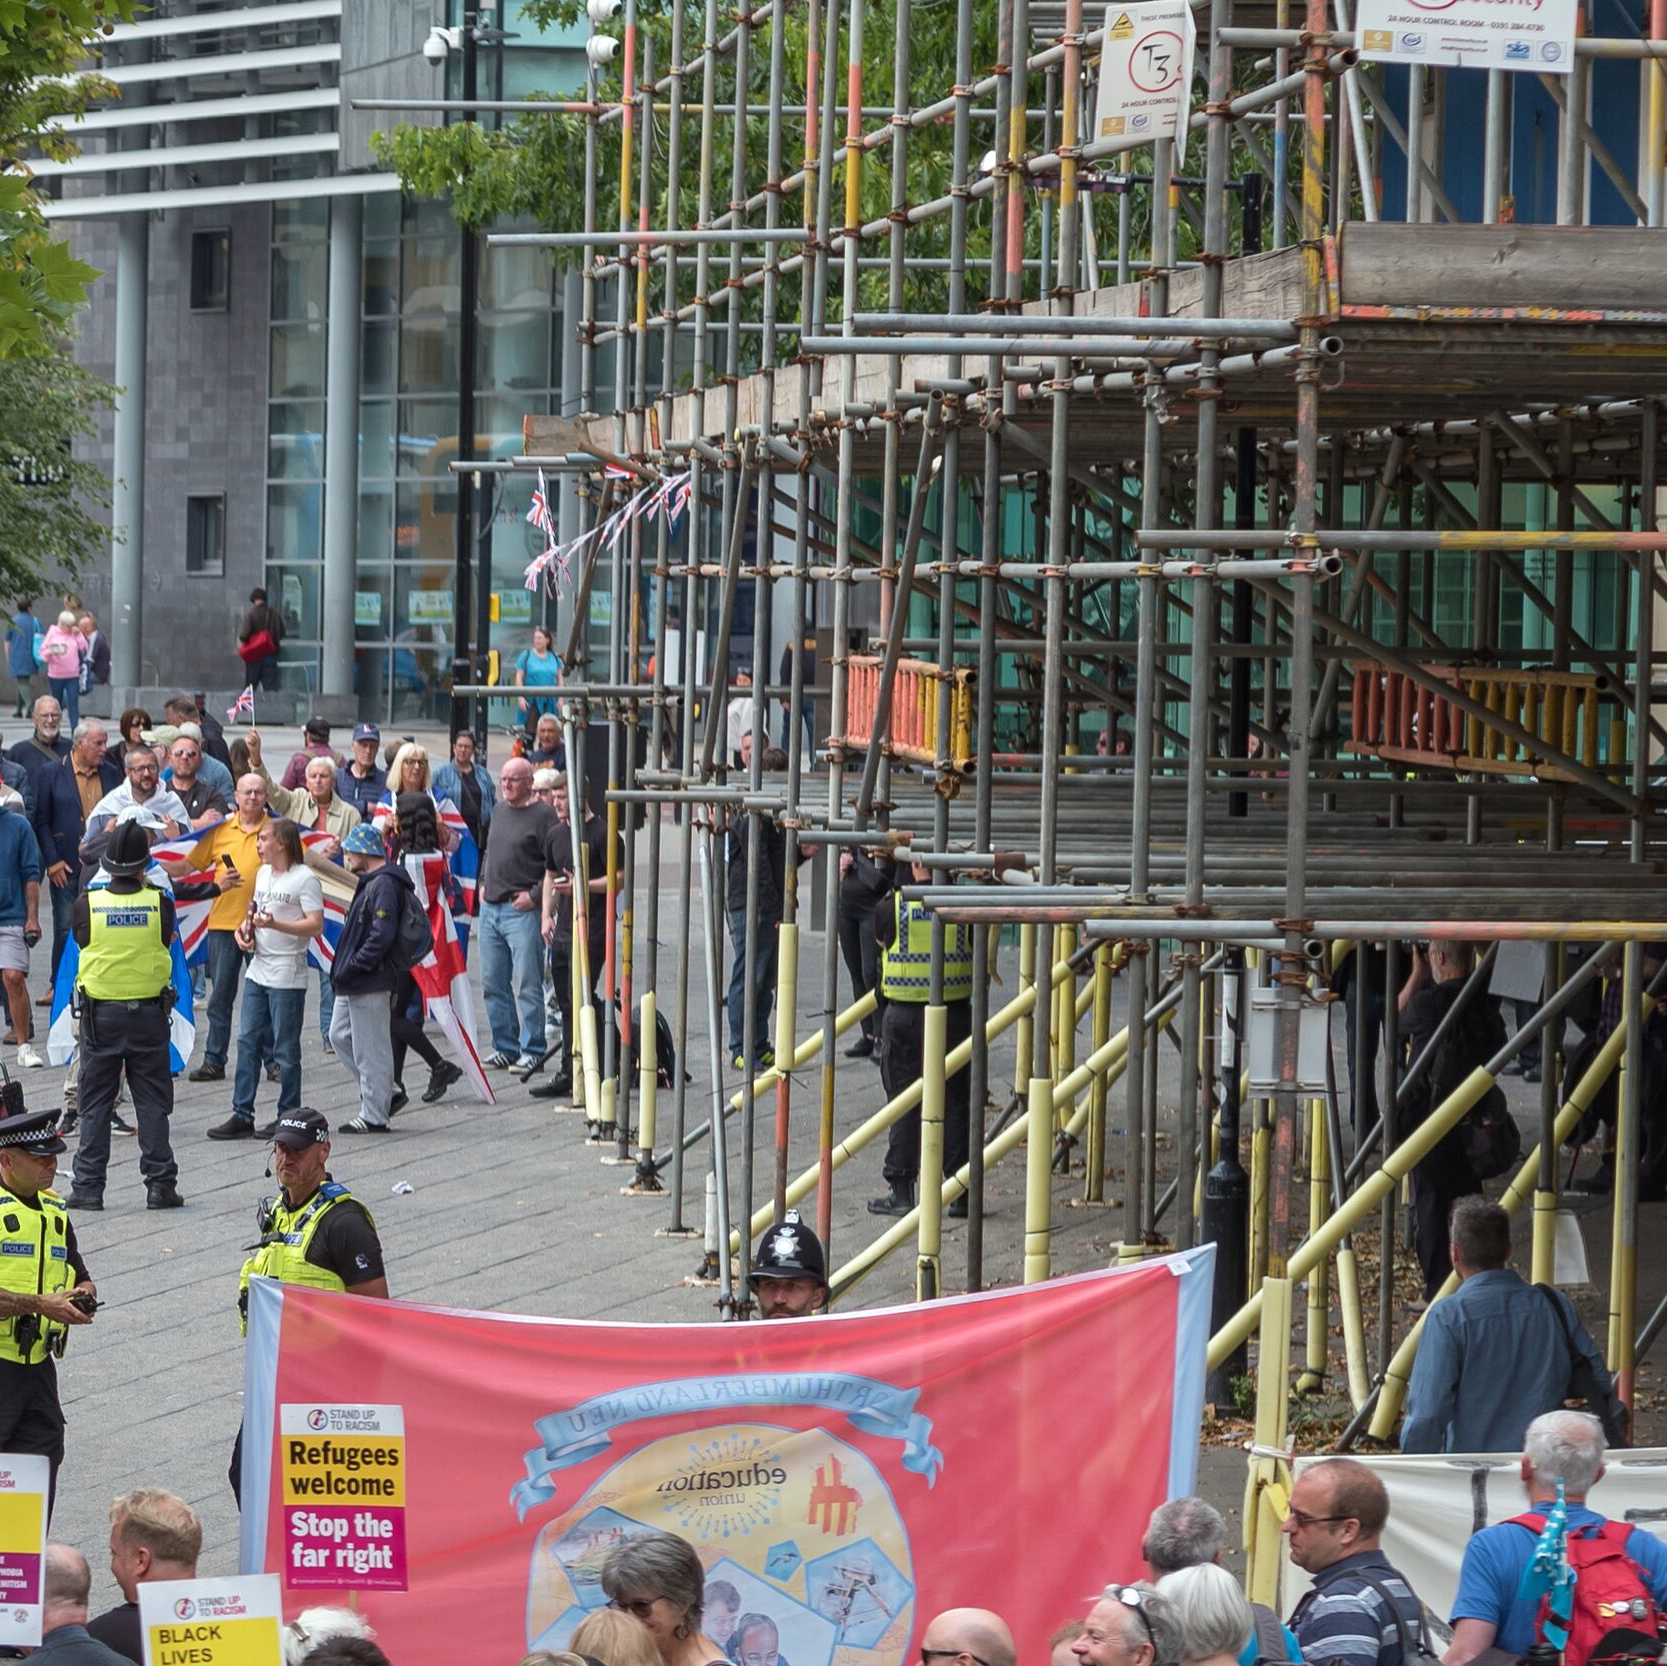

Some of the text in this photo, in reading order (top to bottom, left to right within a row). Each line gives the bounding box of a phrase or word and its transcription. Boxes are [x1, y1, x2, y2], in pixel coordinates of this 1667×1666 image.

[1423, 17, 1458, 26] CONTROL
[108, 914, 148, 925] POLICE
[281, 1118, 308, 1130] POLICE
[3, 1243, 33, 1254] POLICE
[330, 1409, 375, 1419] STAND UP
[331, 1421, 380, 1431] TO RACISM
[289, 1440, 399, 1471] Refugees
[0, 1471, 11, 1479] UP
[291, 1471, 395, 1496] welcome
[291, 1511, 394, 1542] Stop the
[292, 1542, 393, 1574] far right
[198, 1596, 241, 1607] STAND UP
[199, 1606, 247, 1616] TO RACISM
[159, 1626, 222, 1644] BLACK
[160, 1648, 213, 1666] LIVES
